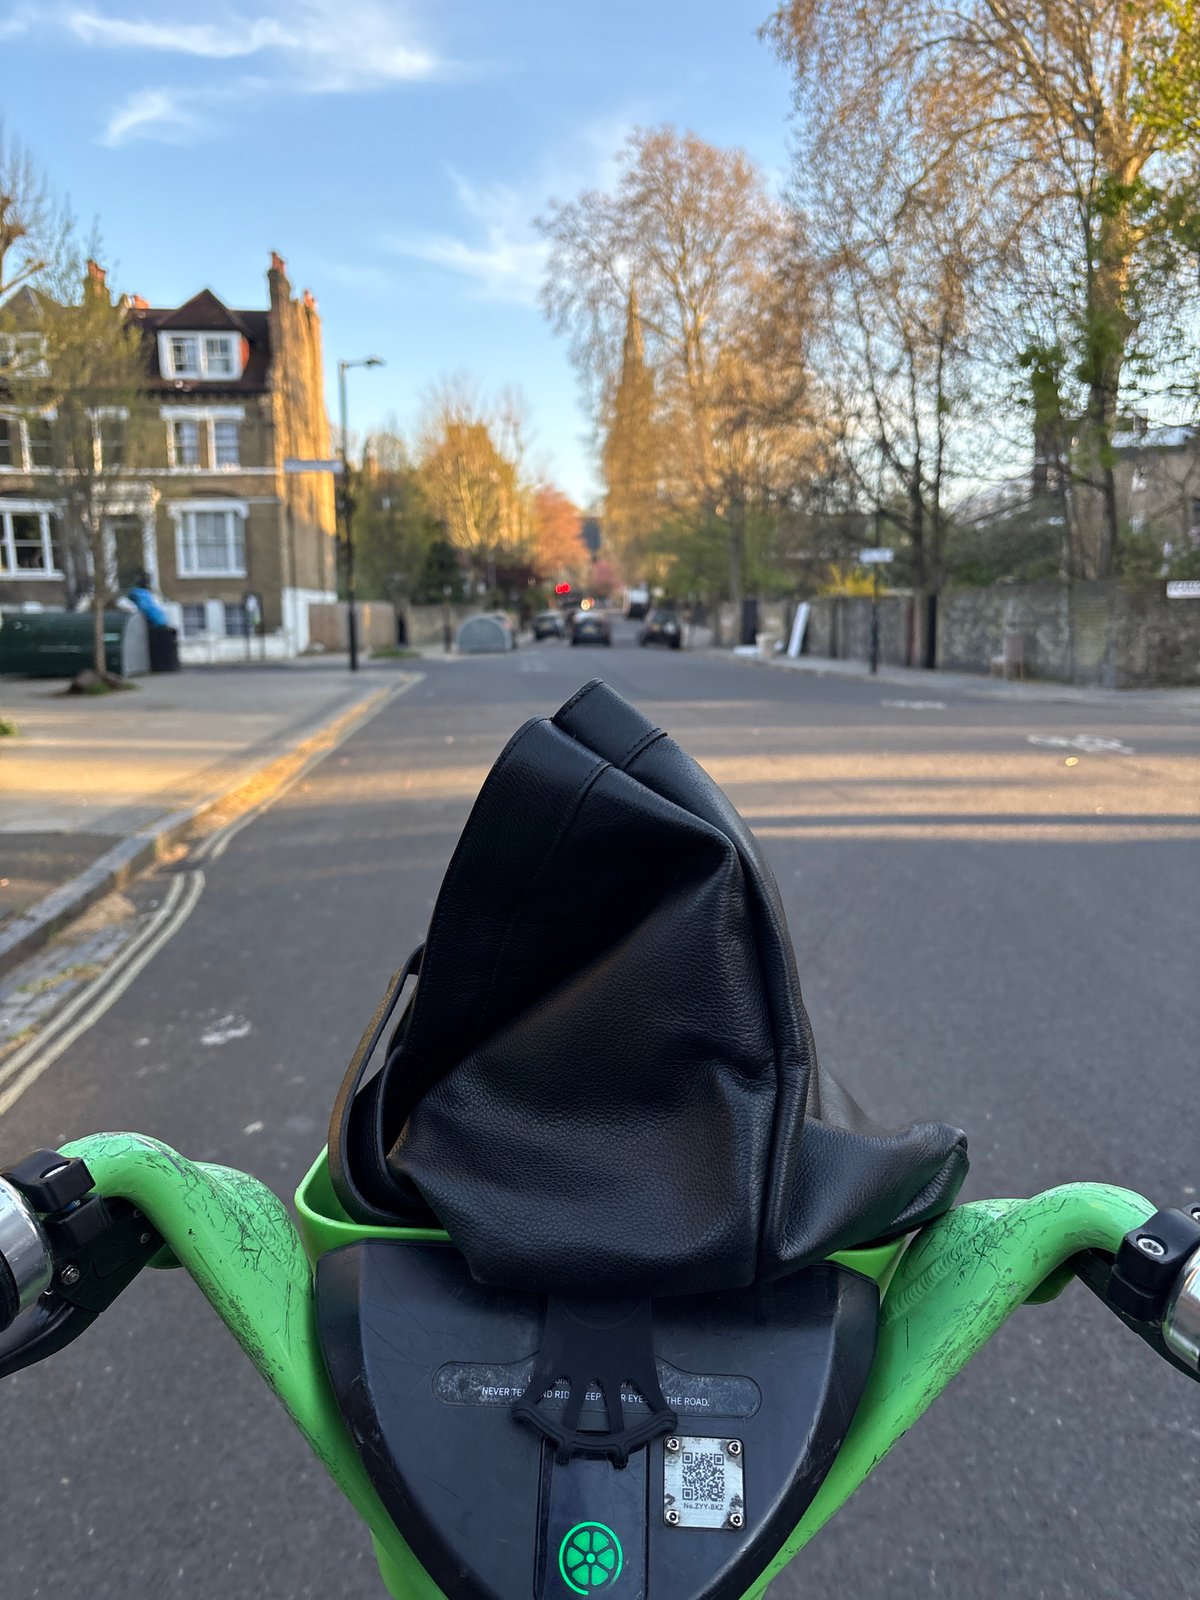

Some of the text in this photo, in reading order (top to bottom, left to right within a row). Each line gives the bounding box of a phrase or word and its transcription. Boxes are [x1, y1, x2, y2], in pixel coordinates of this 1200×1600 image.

[482, 1387, 510, 1396] NEVER
[585, 1392, 602, 1401] EEP
[665, 1396, 683, 1405] THE
[684, 1397, 710, 1407] ROAD.
